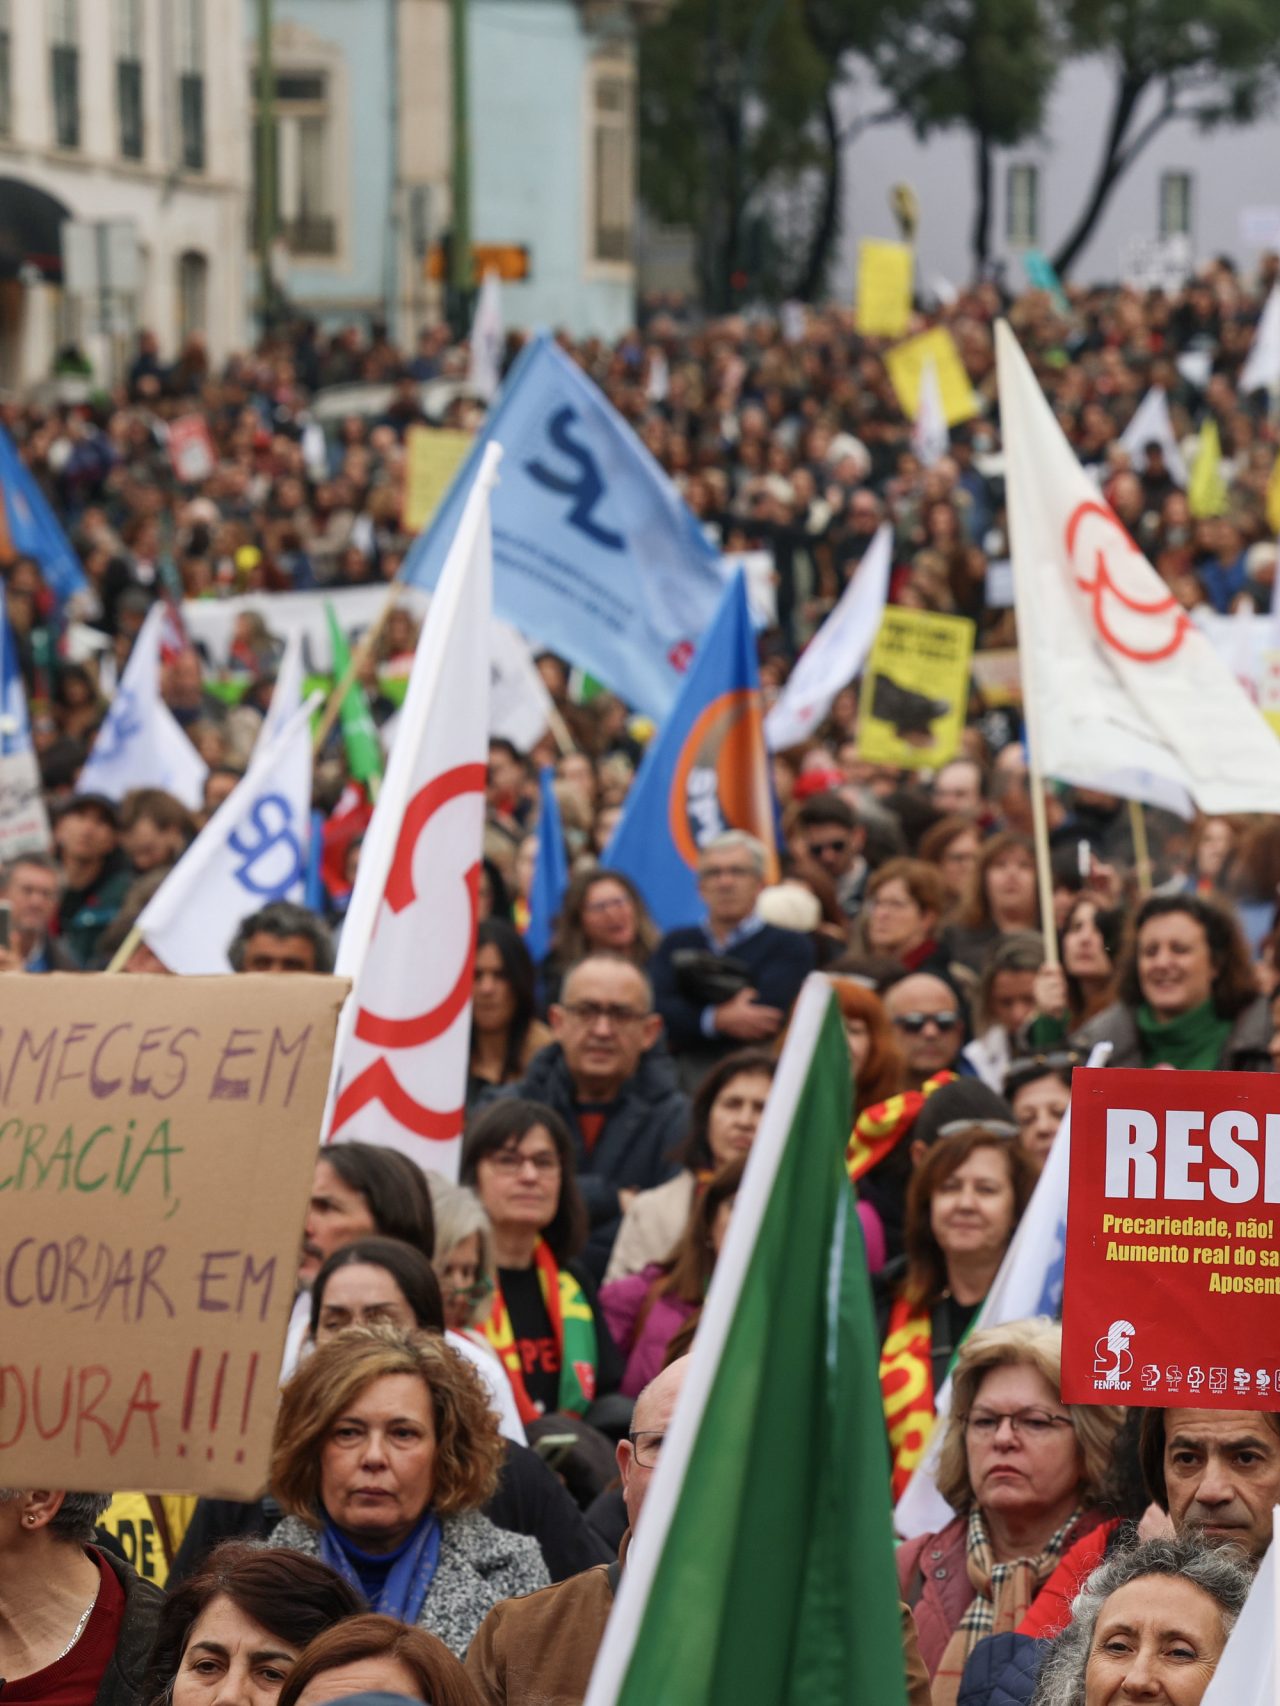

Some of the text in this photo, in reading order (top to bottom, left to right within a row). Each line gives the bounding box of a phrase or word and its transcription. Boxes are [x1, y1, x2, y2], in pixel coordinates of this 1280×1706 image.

[0, 1022, 313, 1107] MECES EM
[1102, 1213, 1232, 1239] Precariedade,
[1235, 1218, 1274, 1239] não!
[1105, 1241, 1189, 1264] Aumento
[1193, 1245, 1230, 1265] real
[1234, 1247, 1256, 1266] do
[197, 1250, 277, 1322] EM
[1093, 1379, 1132, 1391] FENPROF
